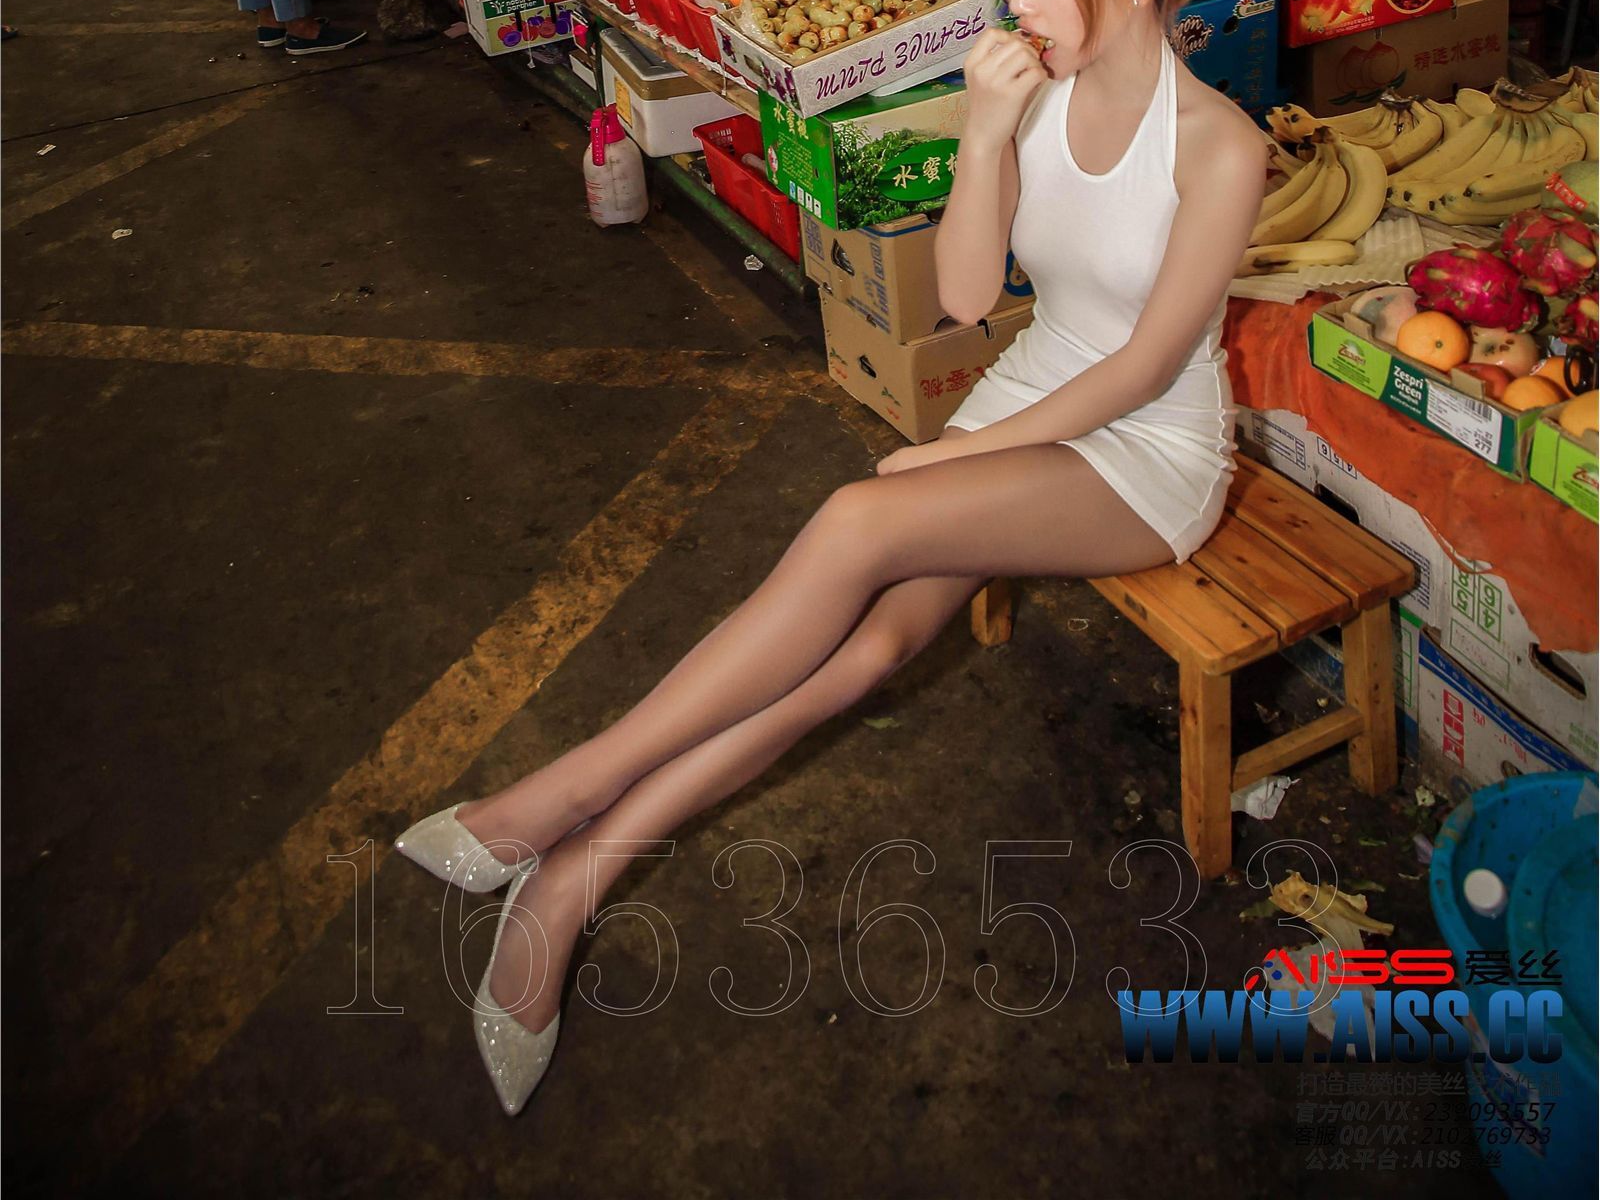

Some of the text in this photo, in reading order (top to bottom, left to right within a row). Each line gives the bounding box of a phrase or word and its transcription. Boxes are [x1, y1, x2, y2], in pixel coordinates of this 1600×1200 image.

[506, 1, 537, 12] partner
[816, 6, 986, 101] FRANCE PLUM
[1394, 365, 1424, 388] Zespri
[1394, 380, 1422, 401] Green
